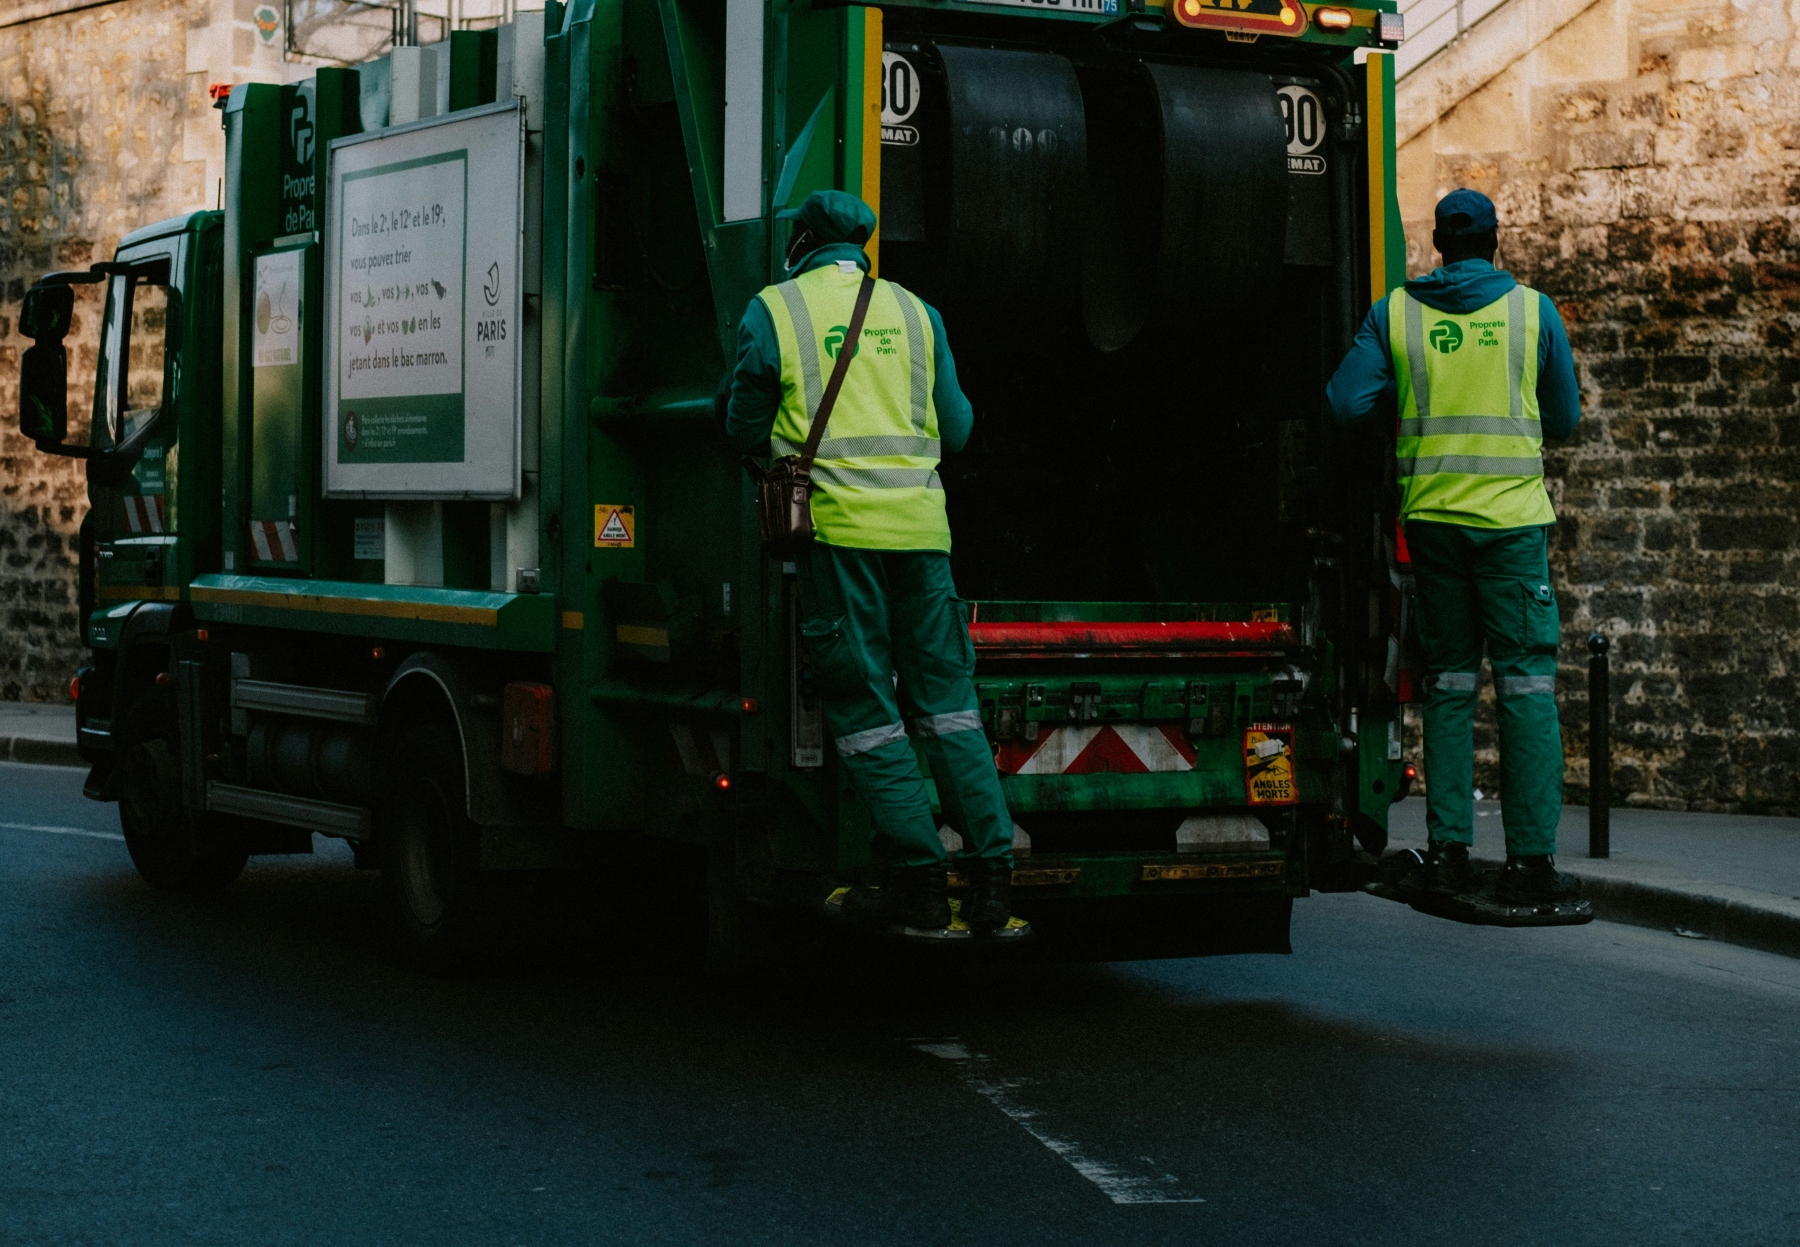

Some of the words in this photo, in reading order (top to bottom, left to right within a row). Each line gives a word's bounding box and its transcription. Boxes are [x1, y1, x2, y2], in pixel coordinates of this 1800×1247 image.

[881, 60, 911, 116] 0
[285, 207, 298, 233] de
[351, 217, 370, 237] Dans
[371, 214, 379, 234] le
[391, 211, 399, 231] le
[412, 211, 421, 227] et
[422, 205, 430, 226] le
[350, 257, 367, 270] vous
[368, 252, 393, 276] pouvez
[395, 243, 412, 264] trier
[350, 291, 362, 304] vos
[382, 287, 395, 300] vos
[416, 283, 429, 296] vos
[350, 325, 361, 337] vos
[377, 319, 385, 335] et
[386, 321, 399, 333] vos
[418, 318, 428, 331] en
[430, 309, 441, 330] les
[477, 318, 507, 342] PARIS
[864, 328, 901, 337] Propreté
[1471, 320, 1505, 329] Propreté
[877, 347, 896, 355] Paris
[1479, 338, 1498, 346] Paris
[349, 351, 371, 377] jetant
[372, 349, 390, 369] dans
[392, 347, 399, 368] le
[400, 346, 414, 368] bac
[416, 351, 448, 366] marron.
[1253, 779, 1291, 789] ANGLES
[1256, 789, 1290, 799] MORTS
